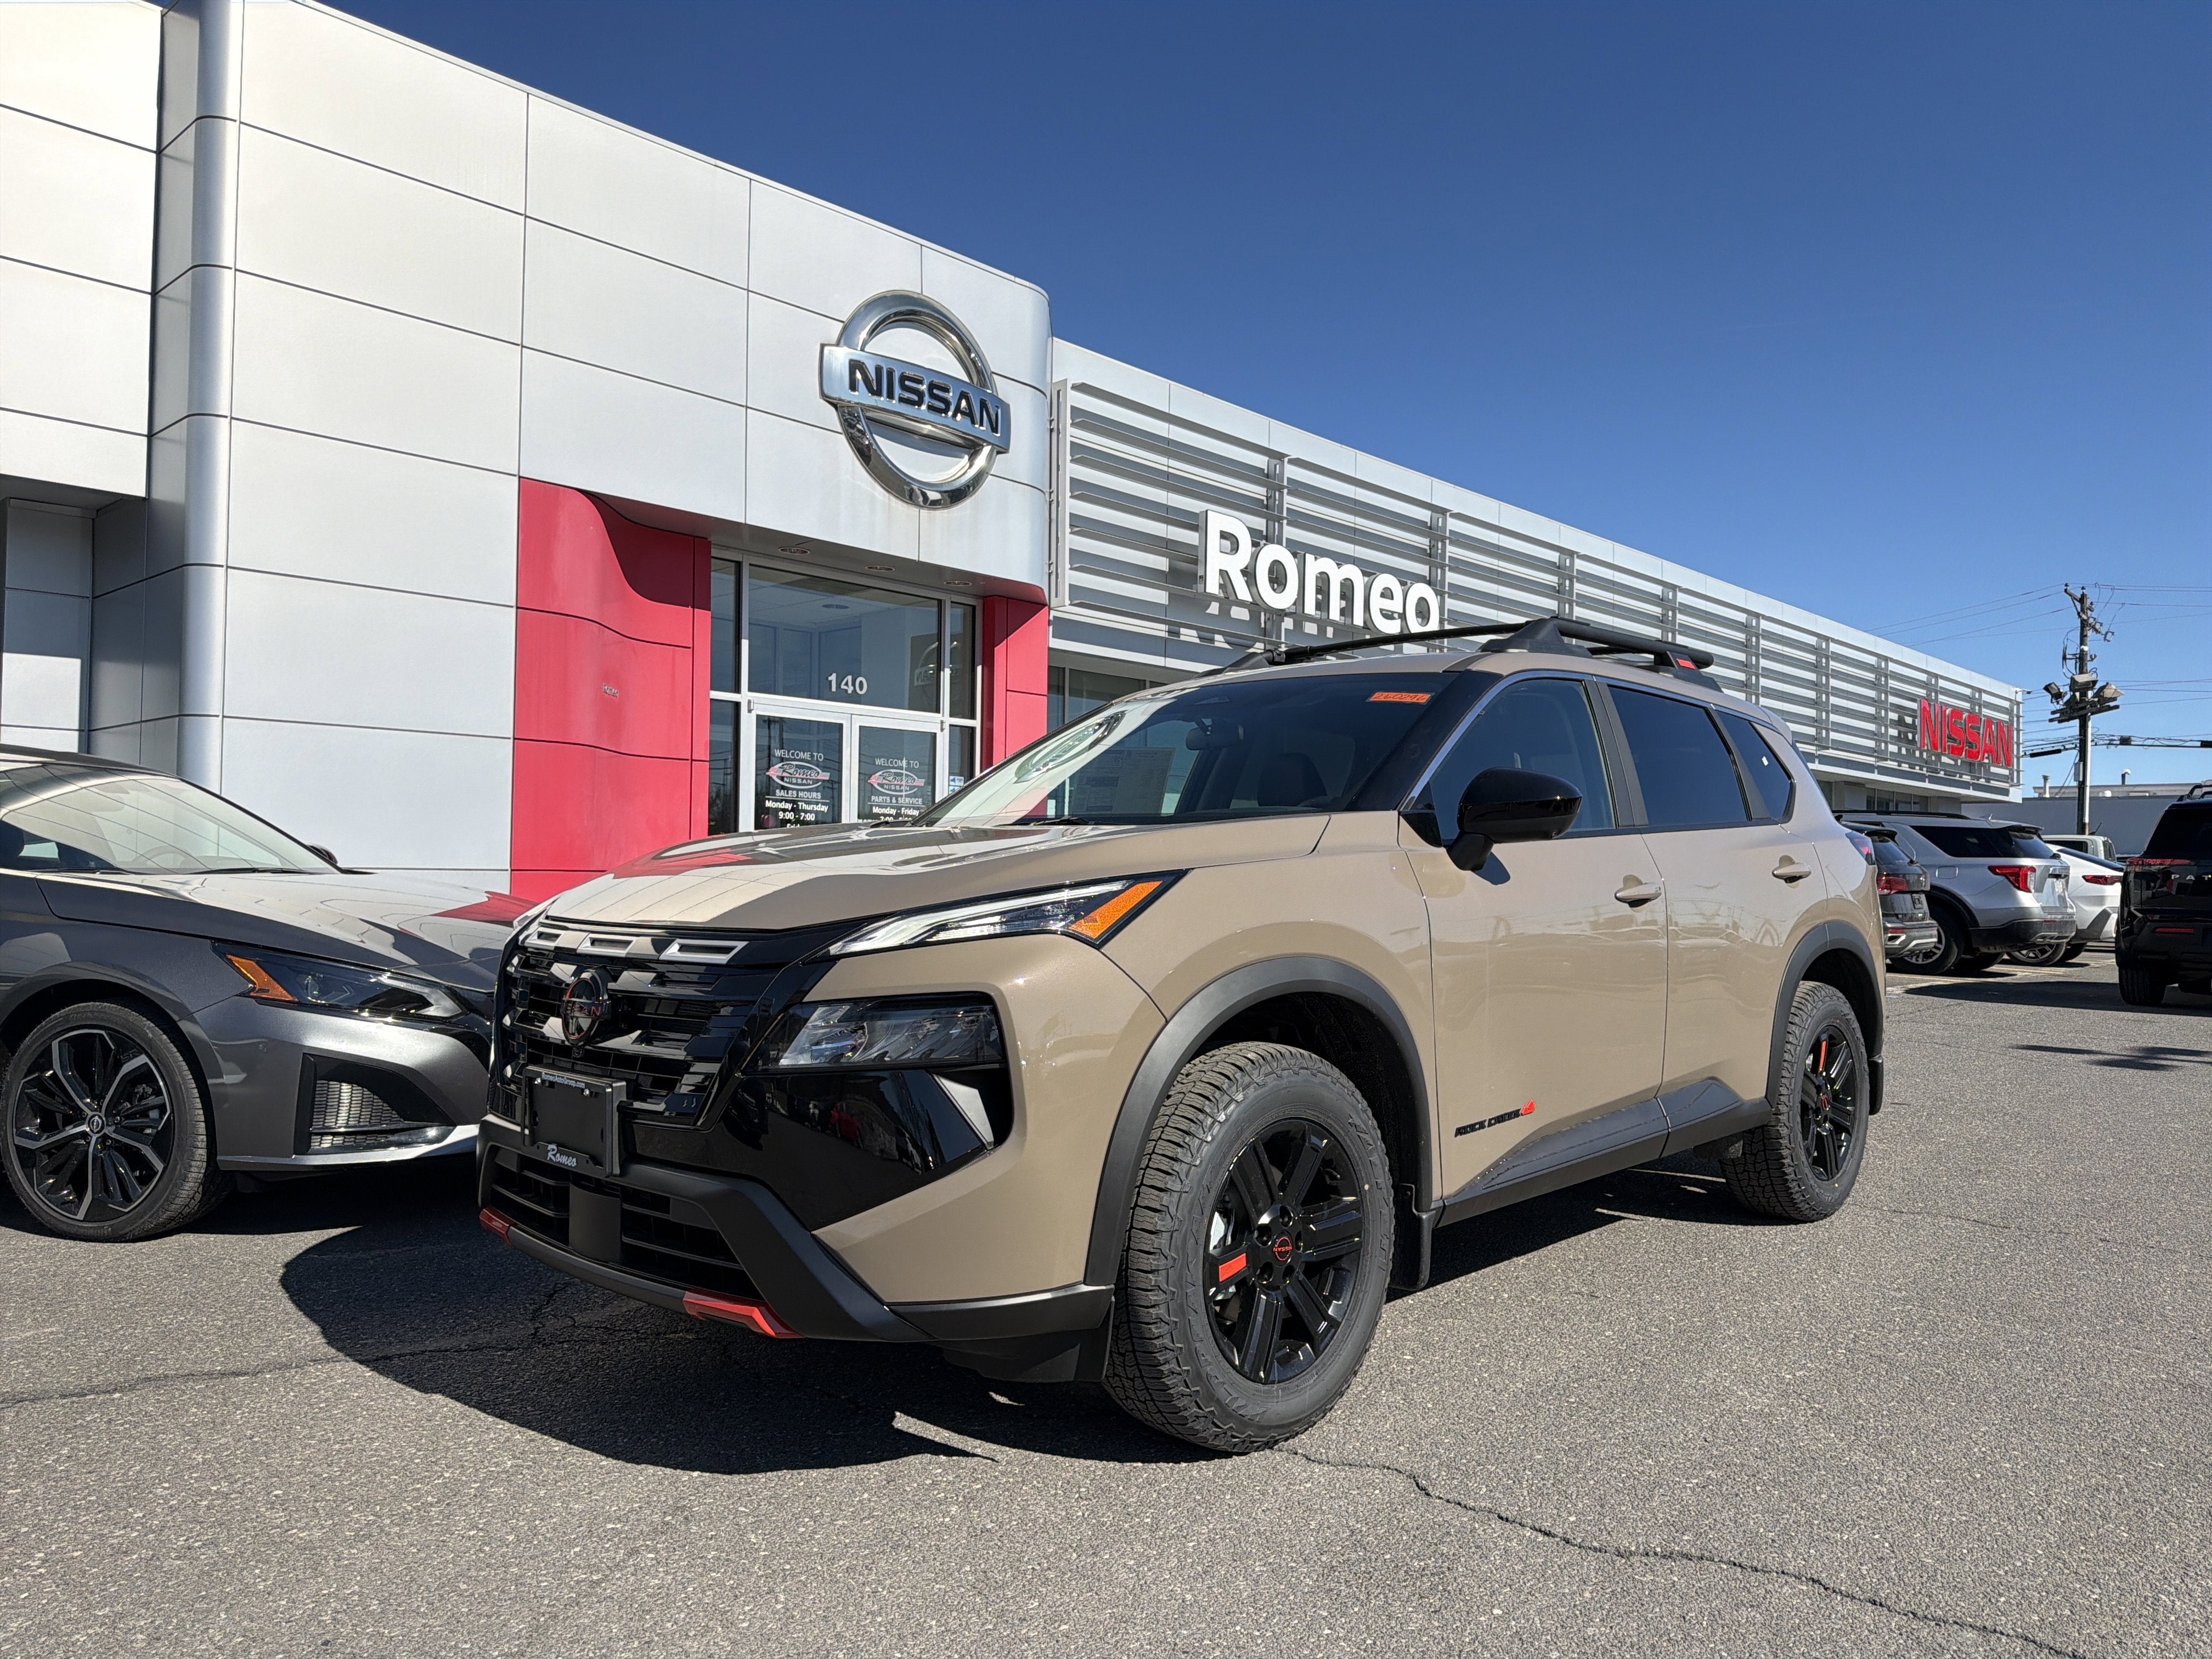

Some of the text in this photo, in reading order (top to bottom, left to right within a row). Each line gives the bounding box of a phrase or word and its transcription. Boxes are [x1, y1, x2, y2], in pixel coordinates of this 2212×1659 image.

[848, 359, 1001, 437] NISSAN
[1198, 509, 1440, 635] Romeo
[828, 673, 868, 695] 140
[1917, 698, 2013, 768] NISSAN
[774, 749, 824, 761] WELCOME TO
[781, 763, 820, 778] Romeo
[875, 758, 919, 769] WELCOME TO
[881, 771, 916, 785] Romeo
[799, 791, 821, 799] HOURS
[765, 800, 793, 810] Monday
[798, 802, 828, 812] Thursday
[872, 806, 896, 816] Monday
[901, 808, 919, 816] Friday
[778, 811, 794, 819] 9:00
[547, 1144, 577, 1167] Romeo
